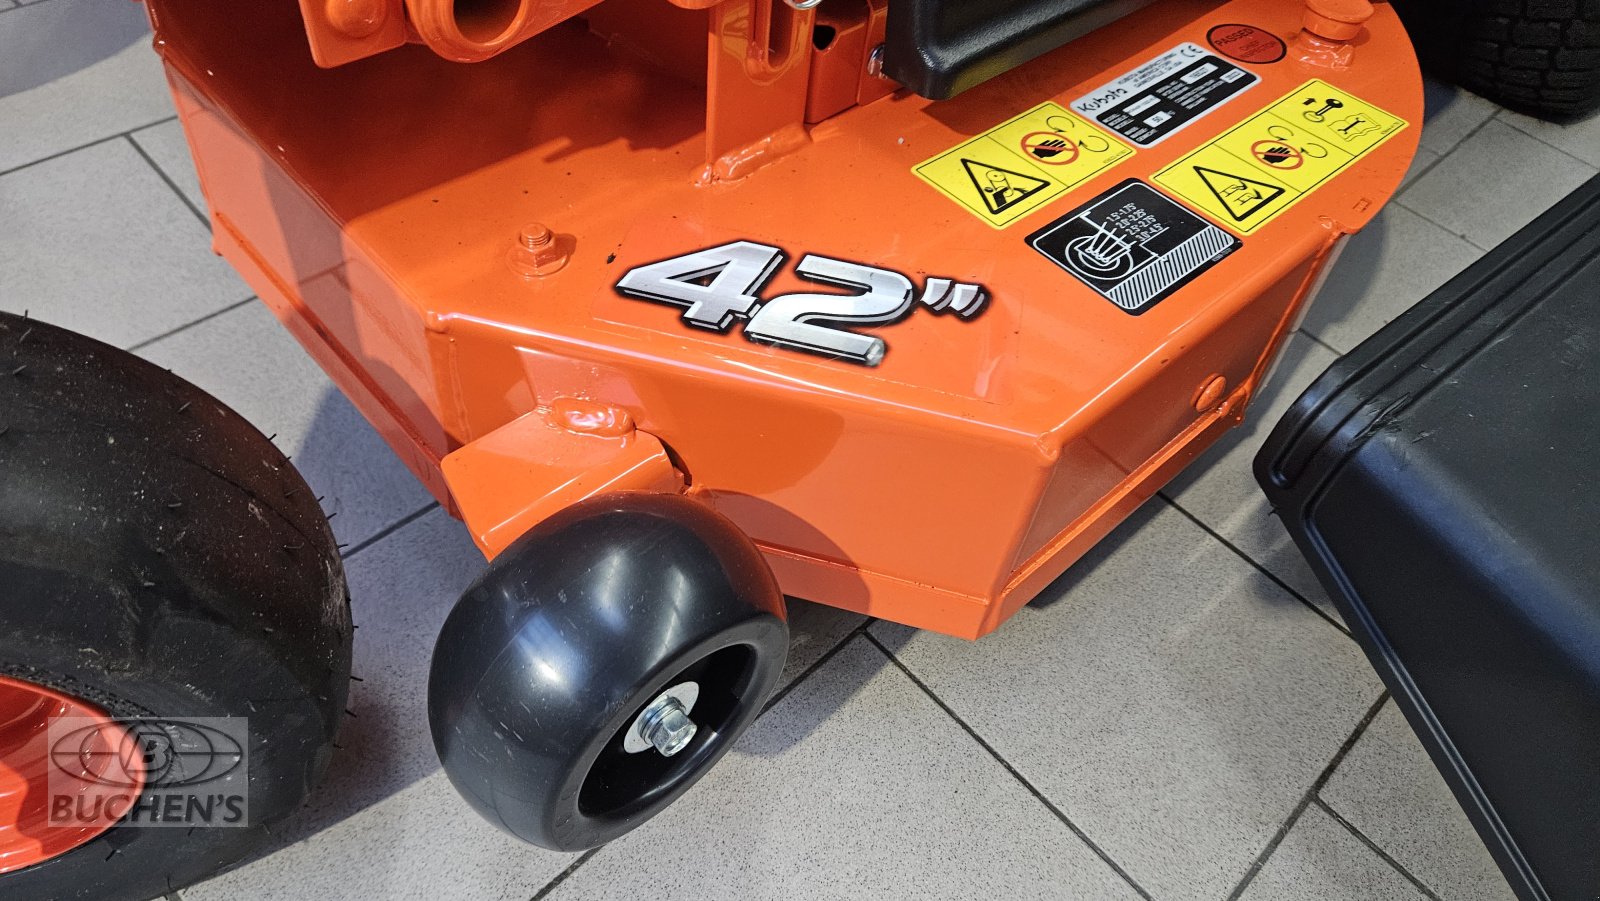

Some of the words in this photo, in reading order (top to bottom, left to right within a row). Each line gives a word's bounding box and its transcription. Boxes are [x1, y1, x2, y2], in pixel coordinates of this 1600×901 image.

[1213, 28, 1255, 46] PASSED
[1077, 87, 1128, 112] Kubota
[1151, 115, 1164, 124] 50
